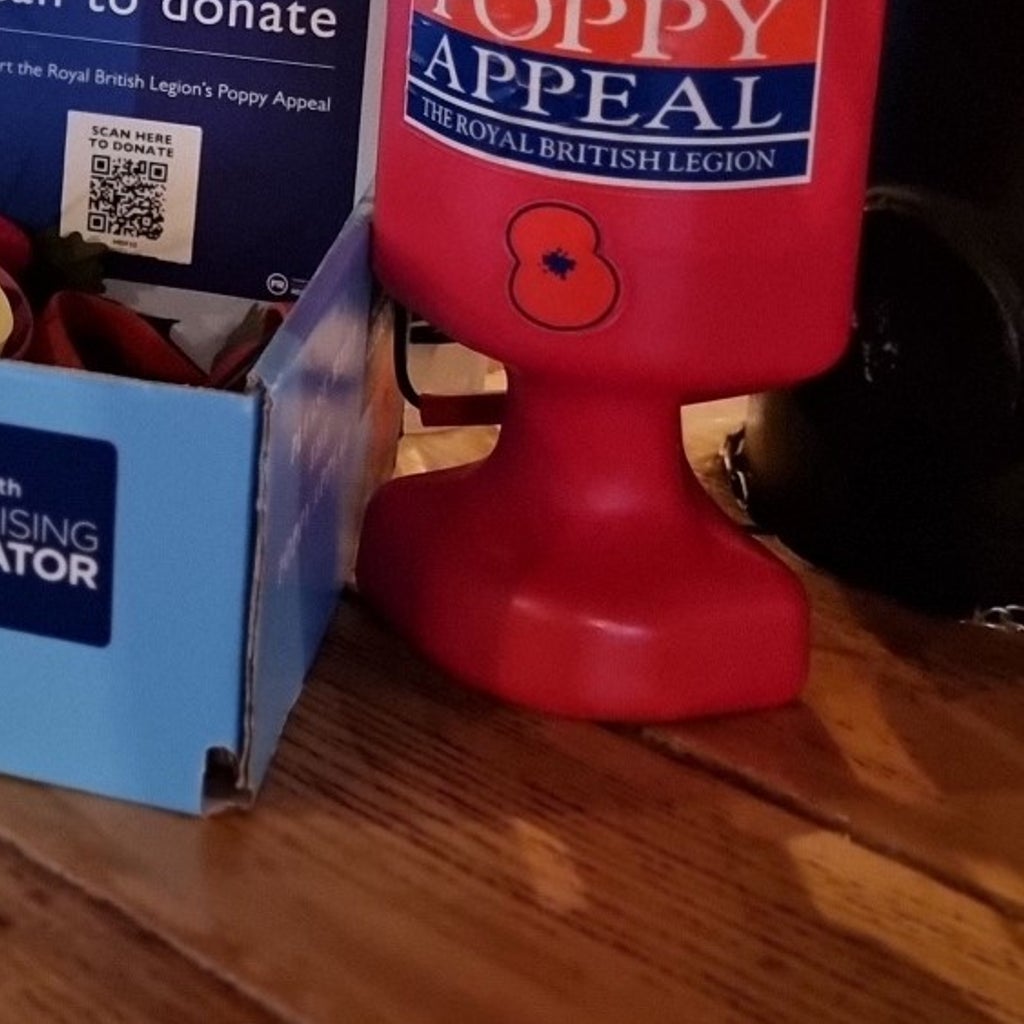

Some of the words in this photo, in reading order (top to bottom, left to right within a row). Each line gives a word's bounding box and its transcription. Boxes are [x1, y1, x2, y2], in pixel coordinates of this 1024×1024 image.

[18, 61, 43, 76] the
[47, 64, 90, 84] Royal
[95, 69, 145, 90] British
[150, 76, 213, 98] Legion's
[219, 85, 268, 109] Poppy
[274, 91, 331, 113] Appeal
[424, 33, 782, 131] APPEAL
[88, 137, 109, 150] TO
[112, 140, 175, 158] DONATE
[91, 125, 131, 140] SCAN
[135, 131, 173, 146] HERE
[422, 97, 454, 132] THE
[456, 116, 534, 156] ROYAL
[539, 139, 661, 173] BRITISH
[668, 148, 776, 174] LEGION
